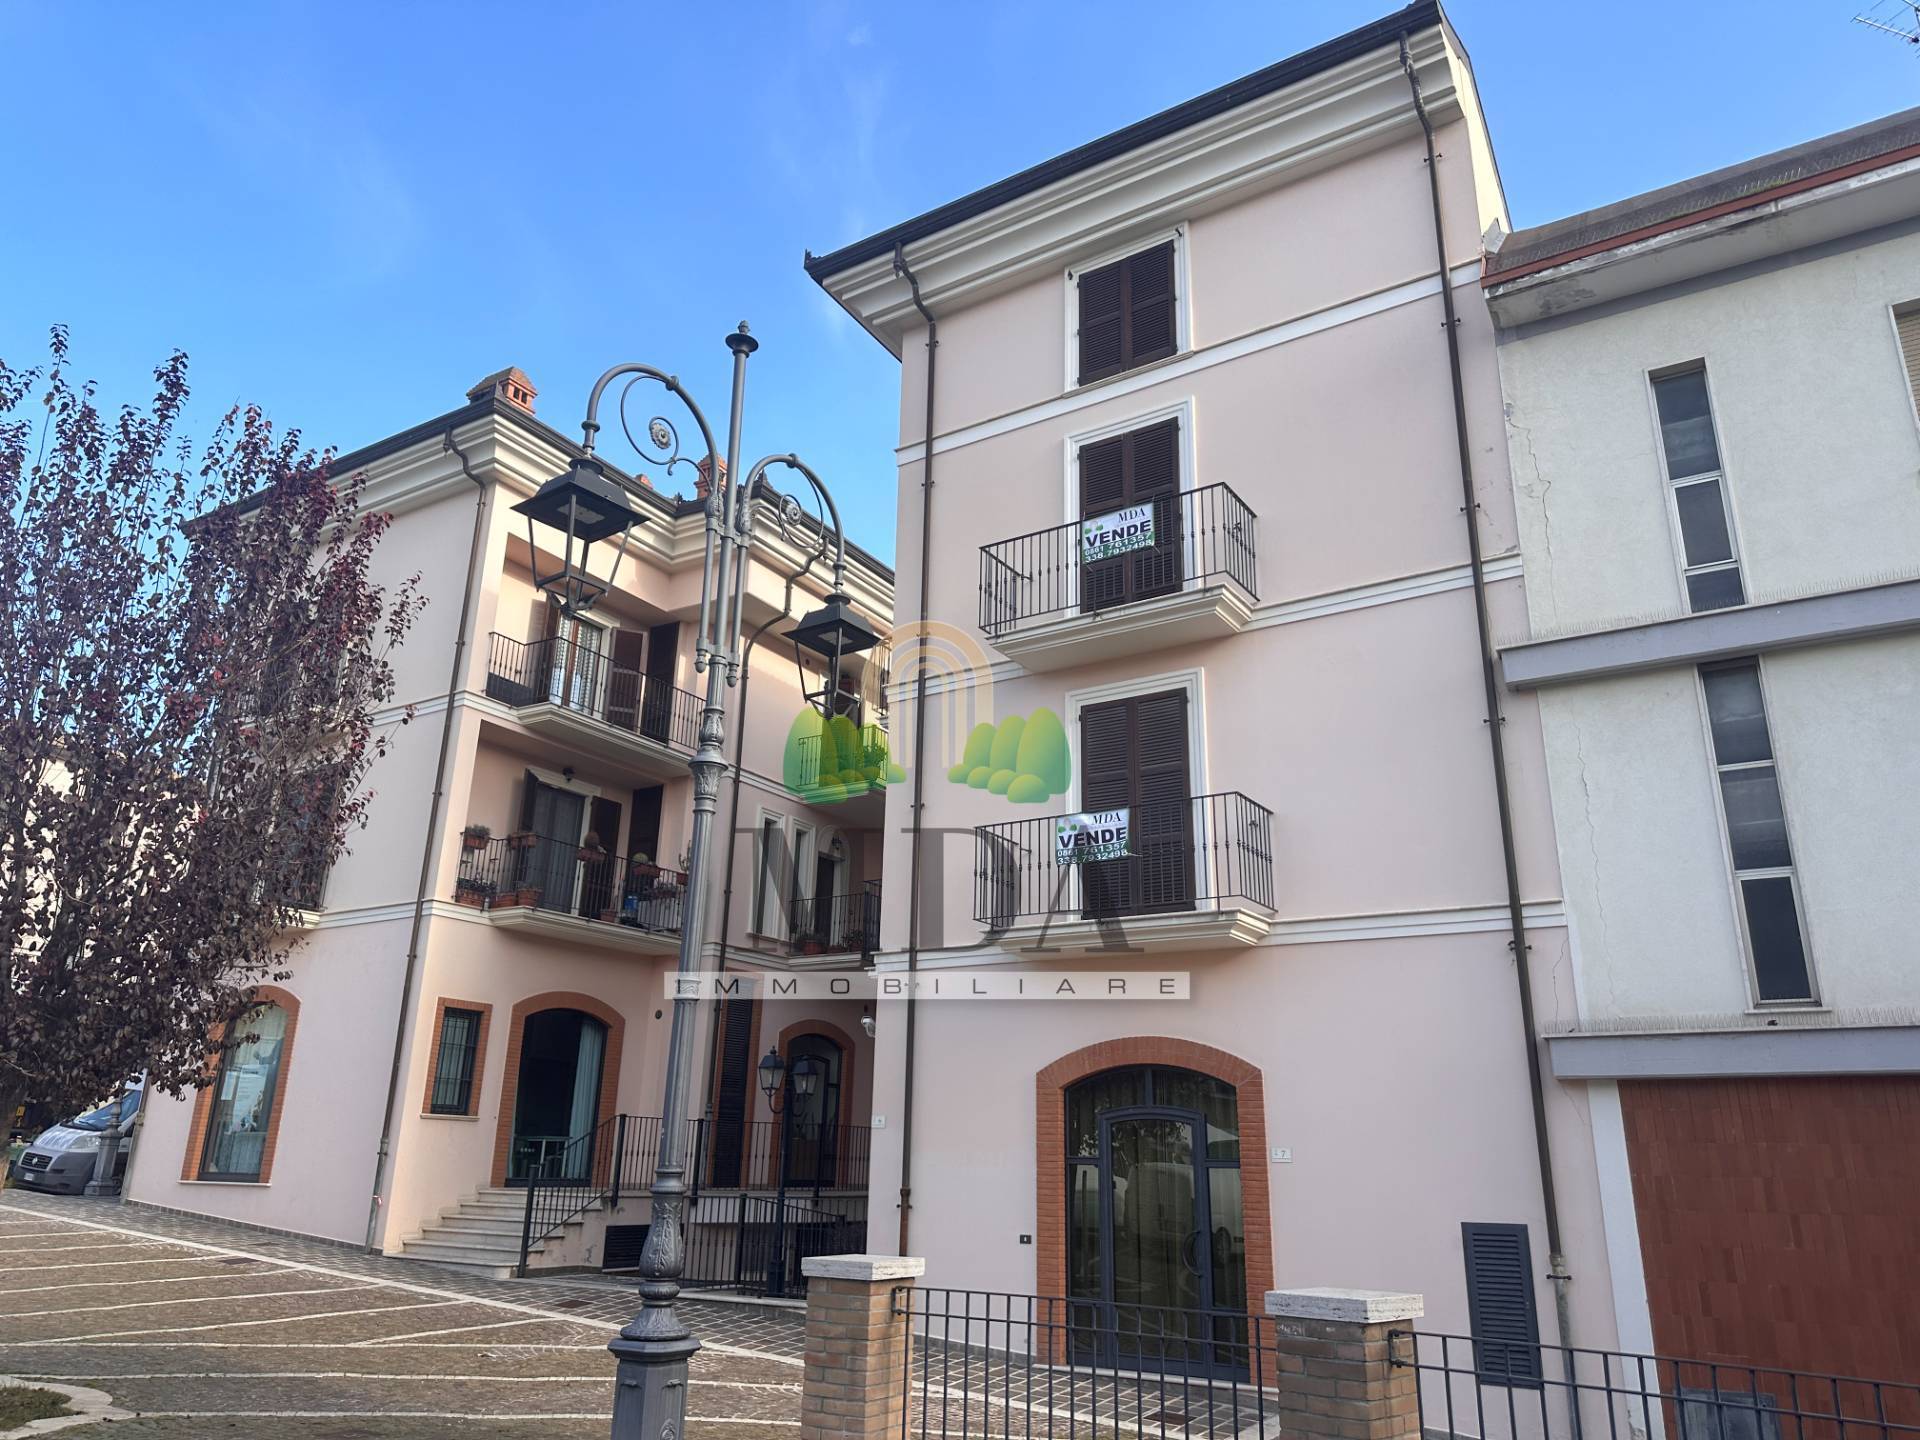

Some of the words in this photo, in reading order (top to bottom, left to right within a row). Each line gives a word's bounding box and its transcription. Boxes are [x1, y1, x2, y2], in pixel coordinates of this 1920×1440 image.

[1118, 507, 1145, 522] MDA
[1085, 520, 1151, 547] VENDE
[1092, 812, 1122, 825] MDA
[1058, 827, 1126, 848] VENDE
